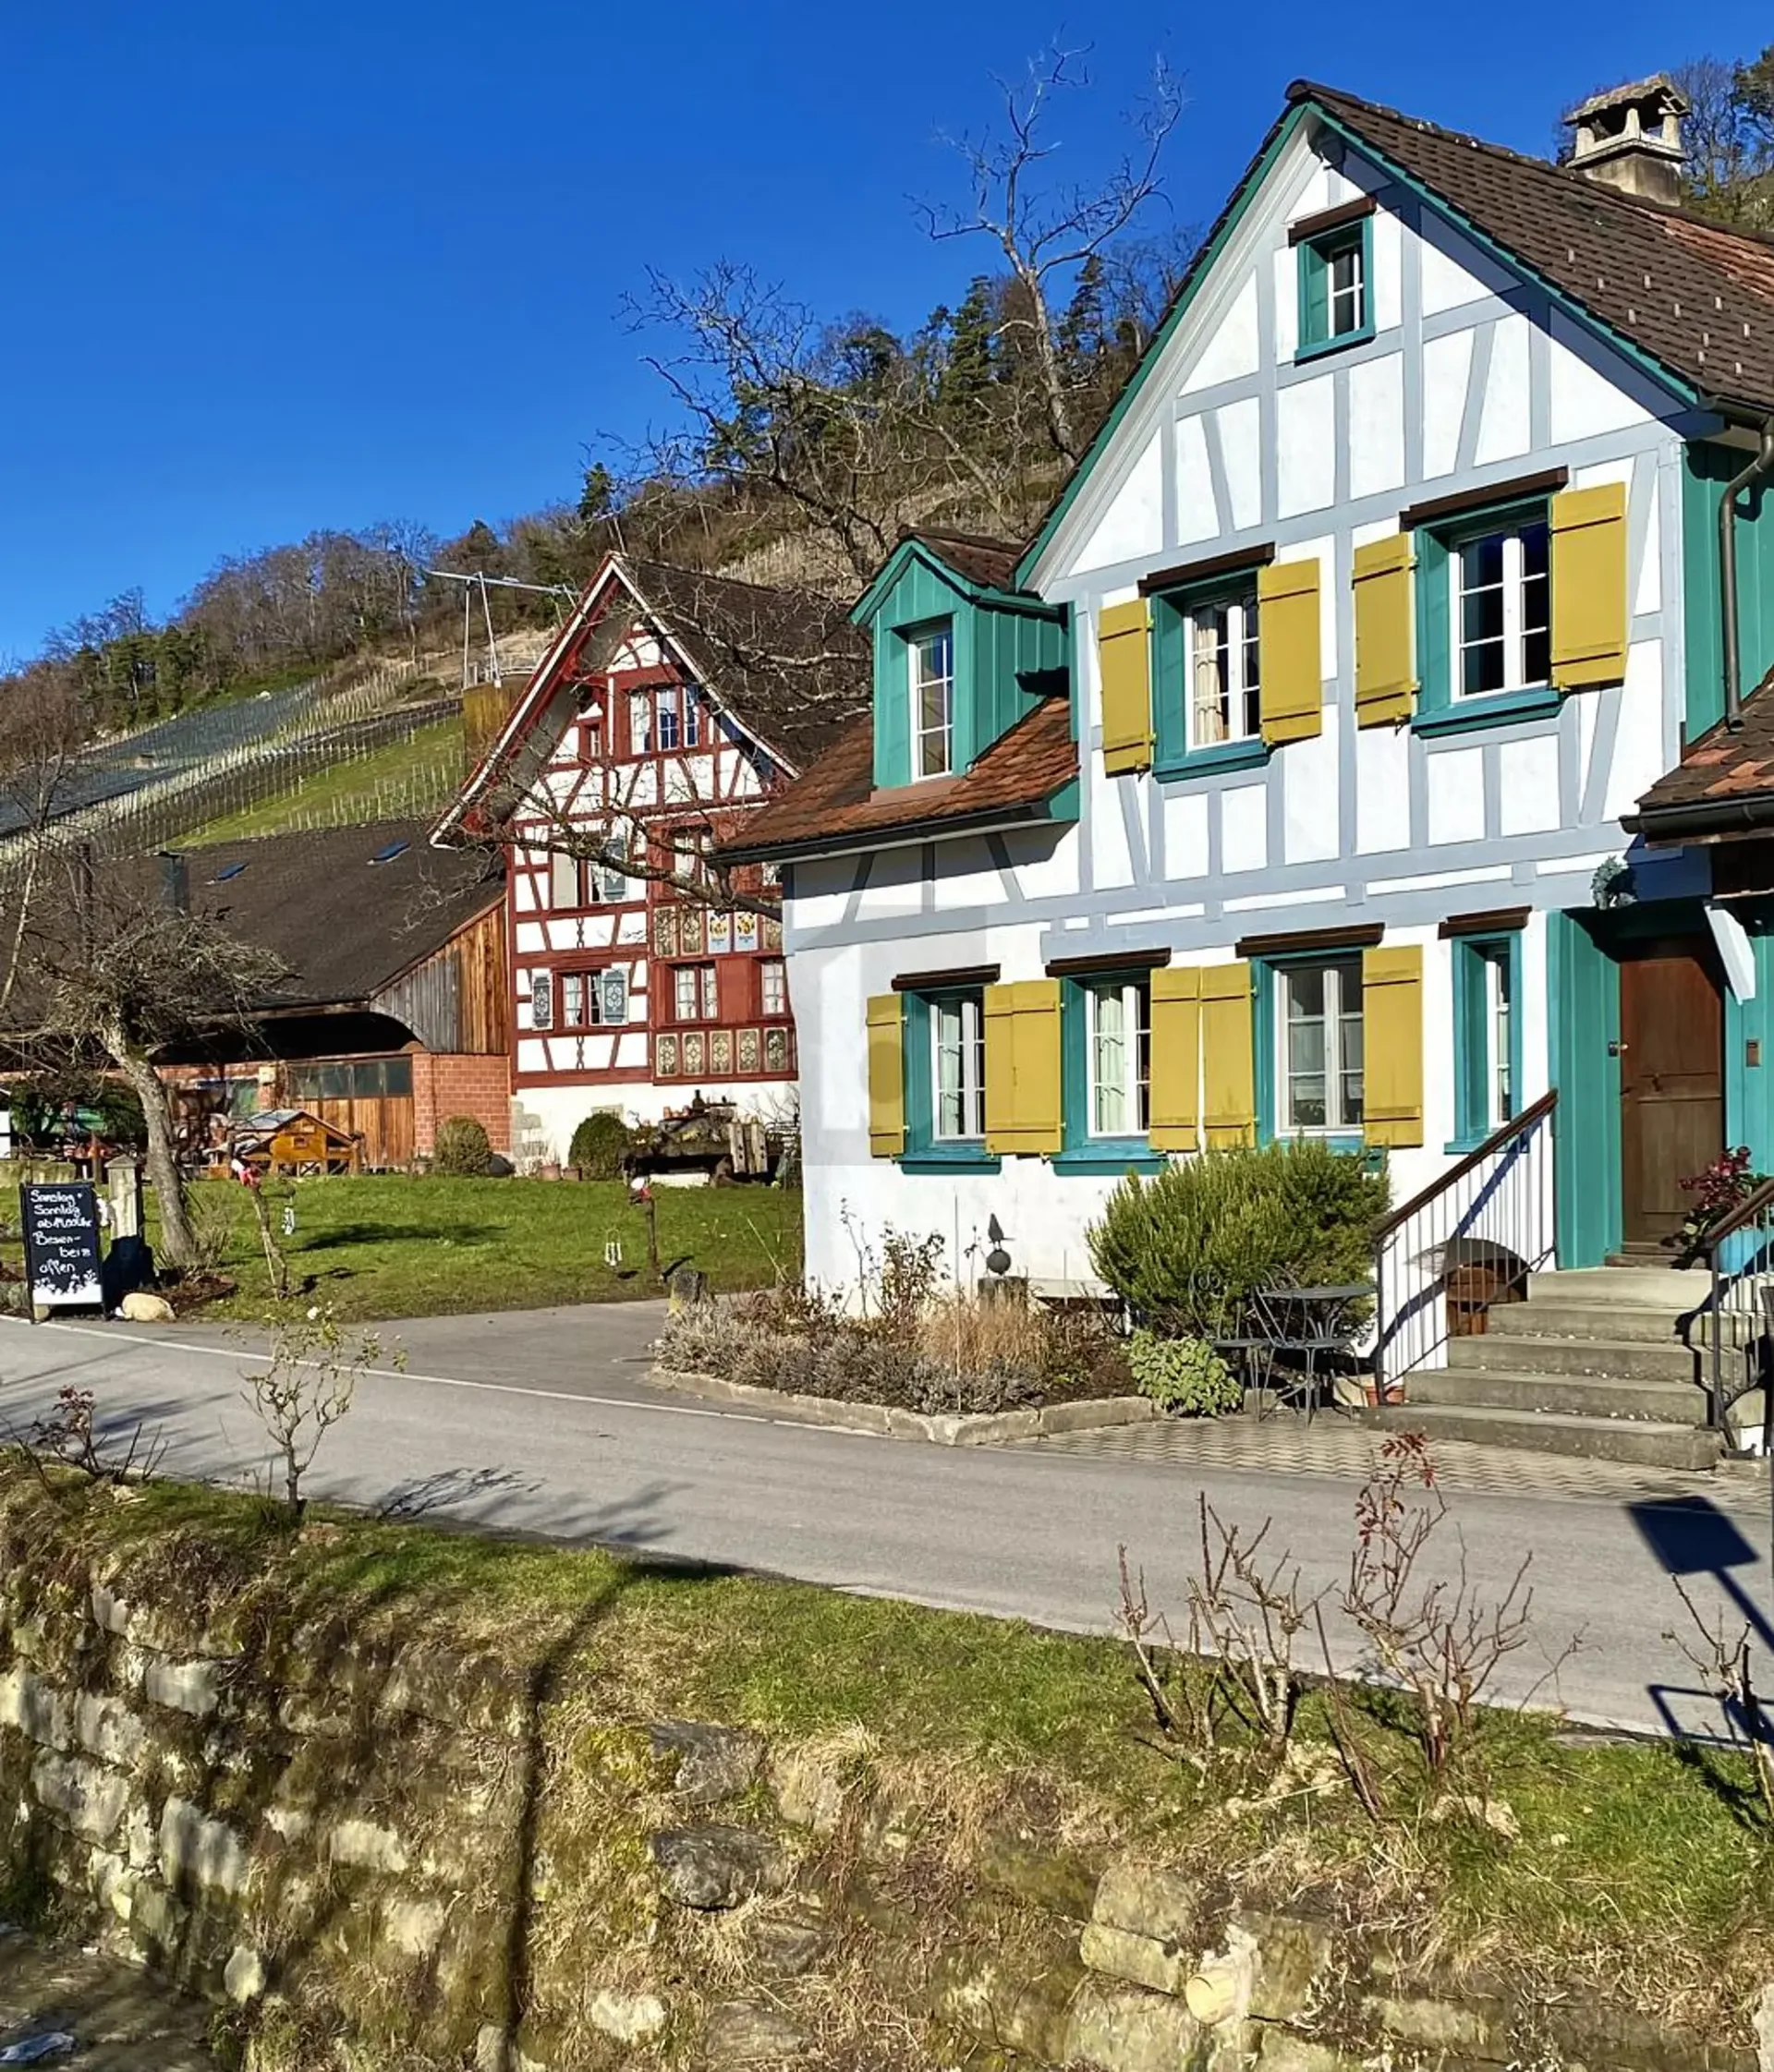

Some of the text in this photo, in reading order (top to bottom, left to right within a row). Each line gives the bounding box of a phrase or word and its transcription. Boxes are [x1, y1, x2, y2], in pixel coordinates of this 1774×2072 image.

[34, 1204, 81, 1218] Sonntag
[37, 1218, 53, 1229] ab
[39, 1258, 76, 1276] offen
